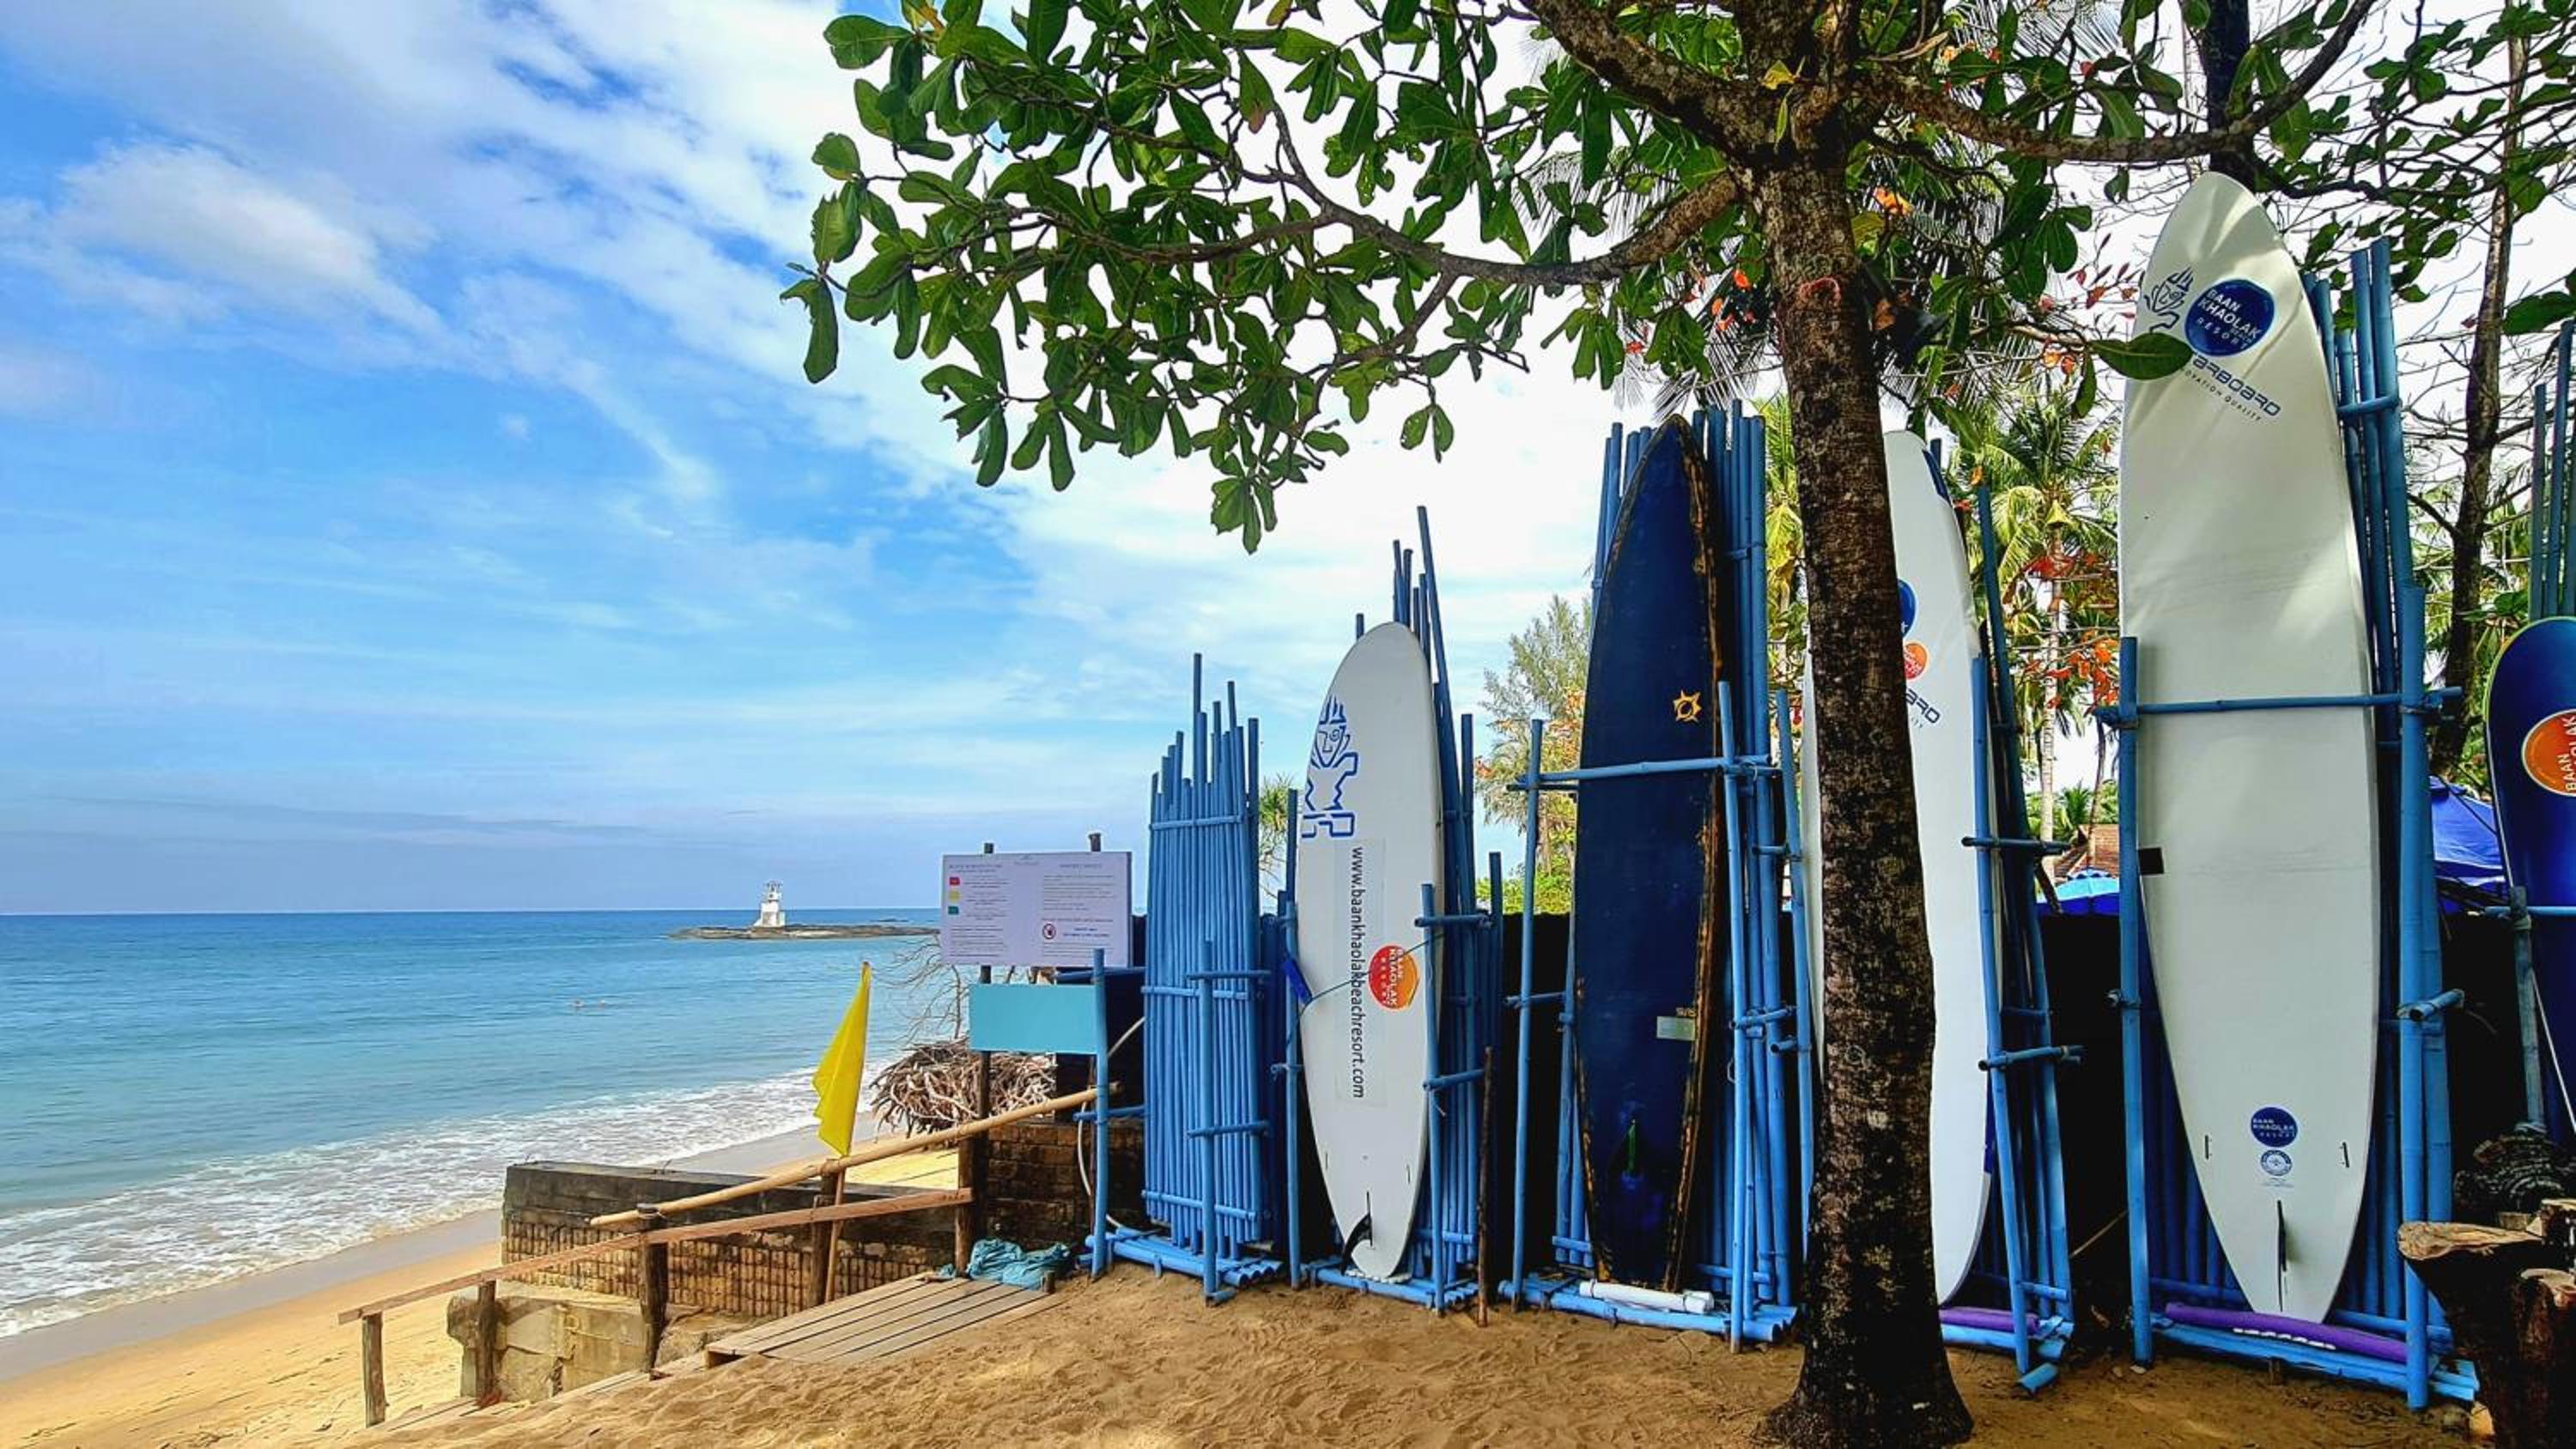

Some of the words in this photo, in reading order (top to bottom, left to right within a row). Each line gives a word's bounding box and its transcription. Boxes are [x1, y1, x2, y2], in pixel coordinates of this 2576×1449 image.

[2197, 298, 2263, 339] KHAOLAK
[2207, 289, 2241, 312] BAAN
[1351, 847, 1365, 1098] www.baankhaolakbeachresort.com
